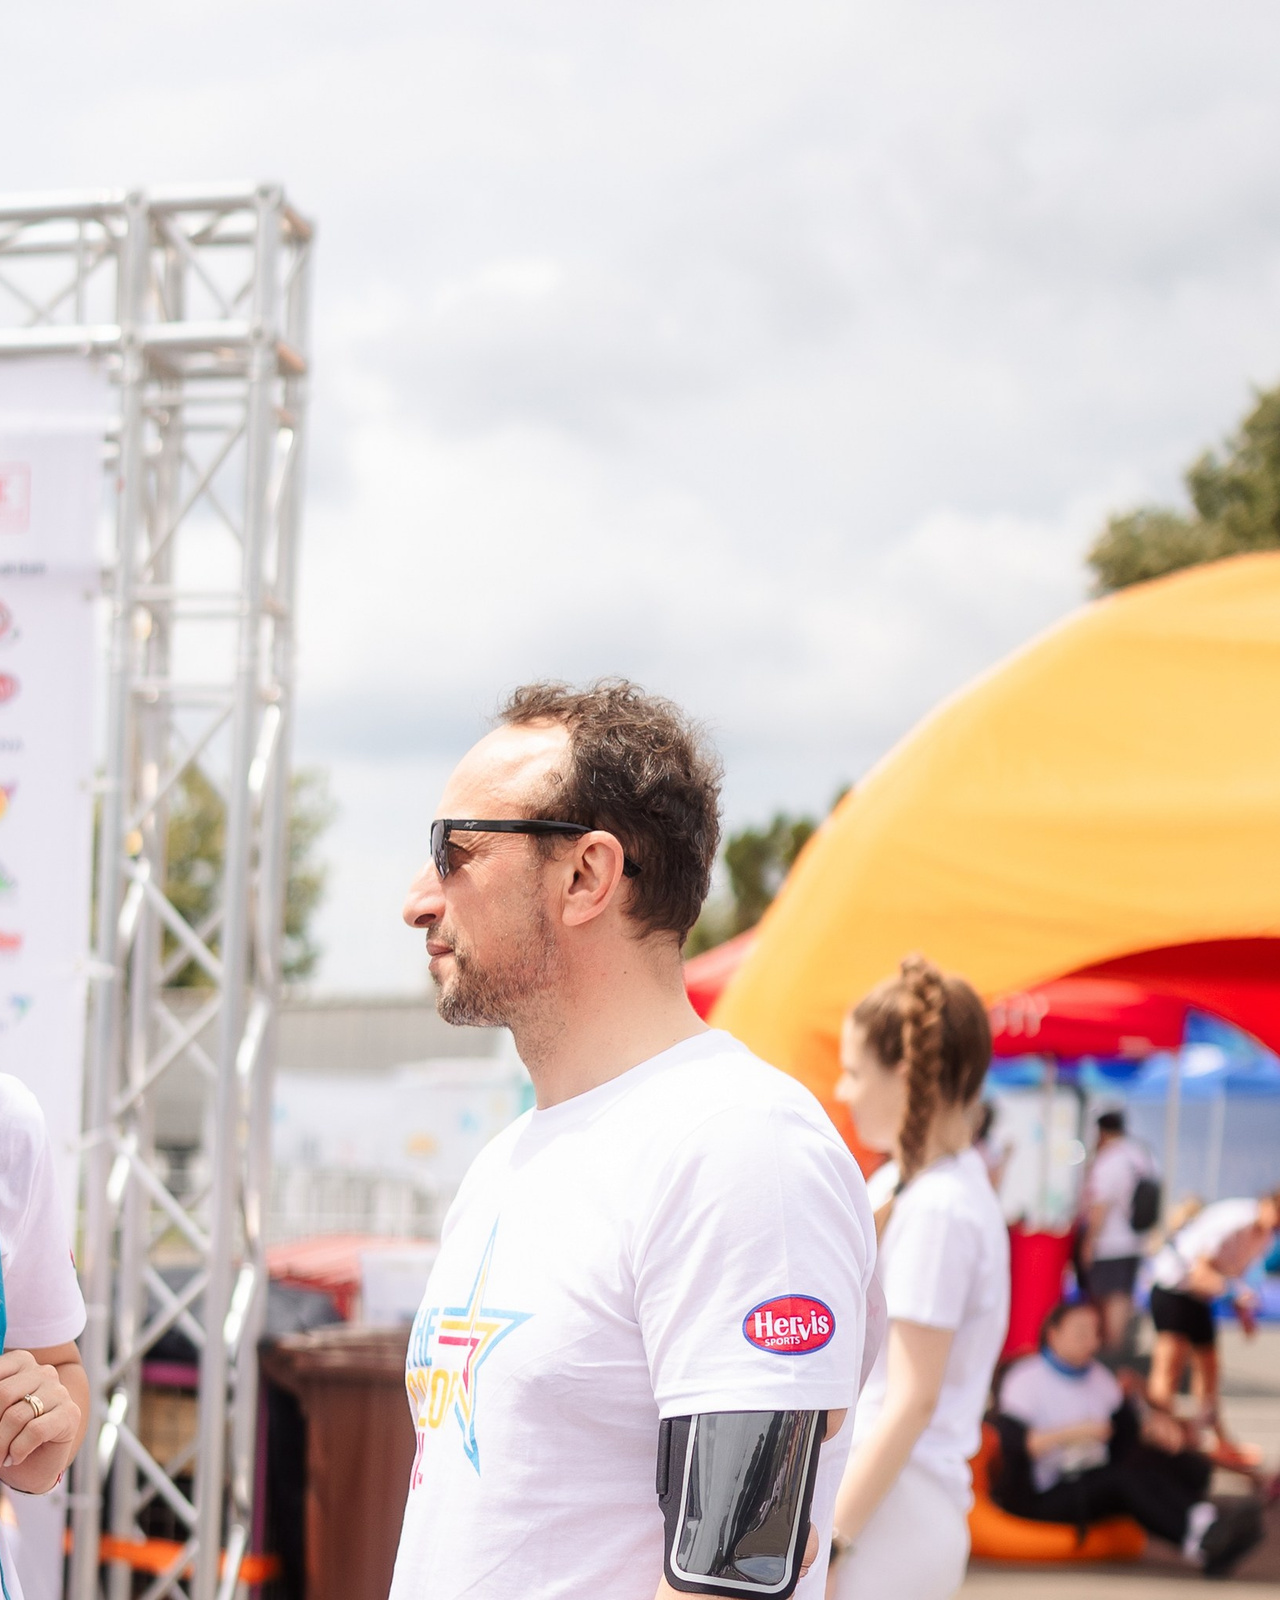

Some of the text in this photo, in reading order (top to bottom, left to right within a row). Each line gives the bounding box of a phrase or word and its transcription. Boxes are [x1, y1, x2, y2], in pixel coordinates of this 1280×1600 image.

[407, 1307, 439, 1369] HE
[754, 1310, 830, 1341] Hervis
[764, 1336, 801, 1347] SPORTS
